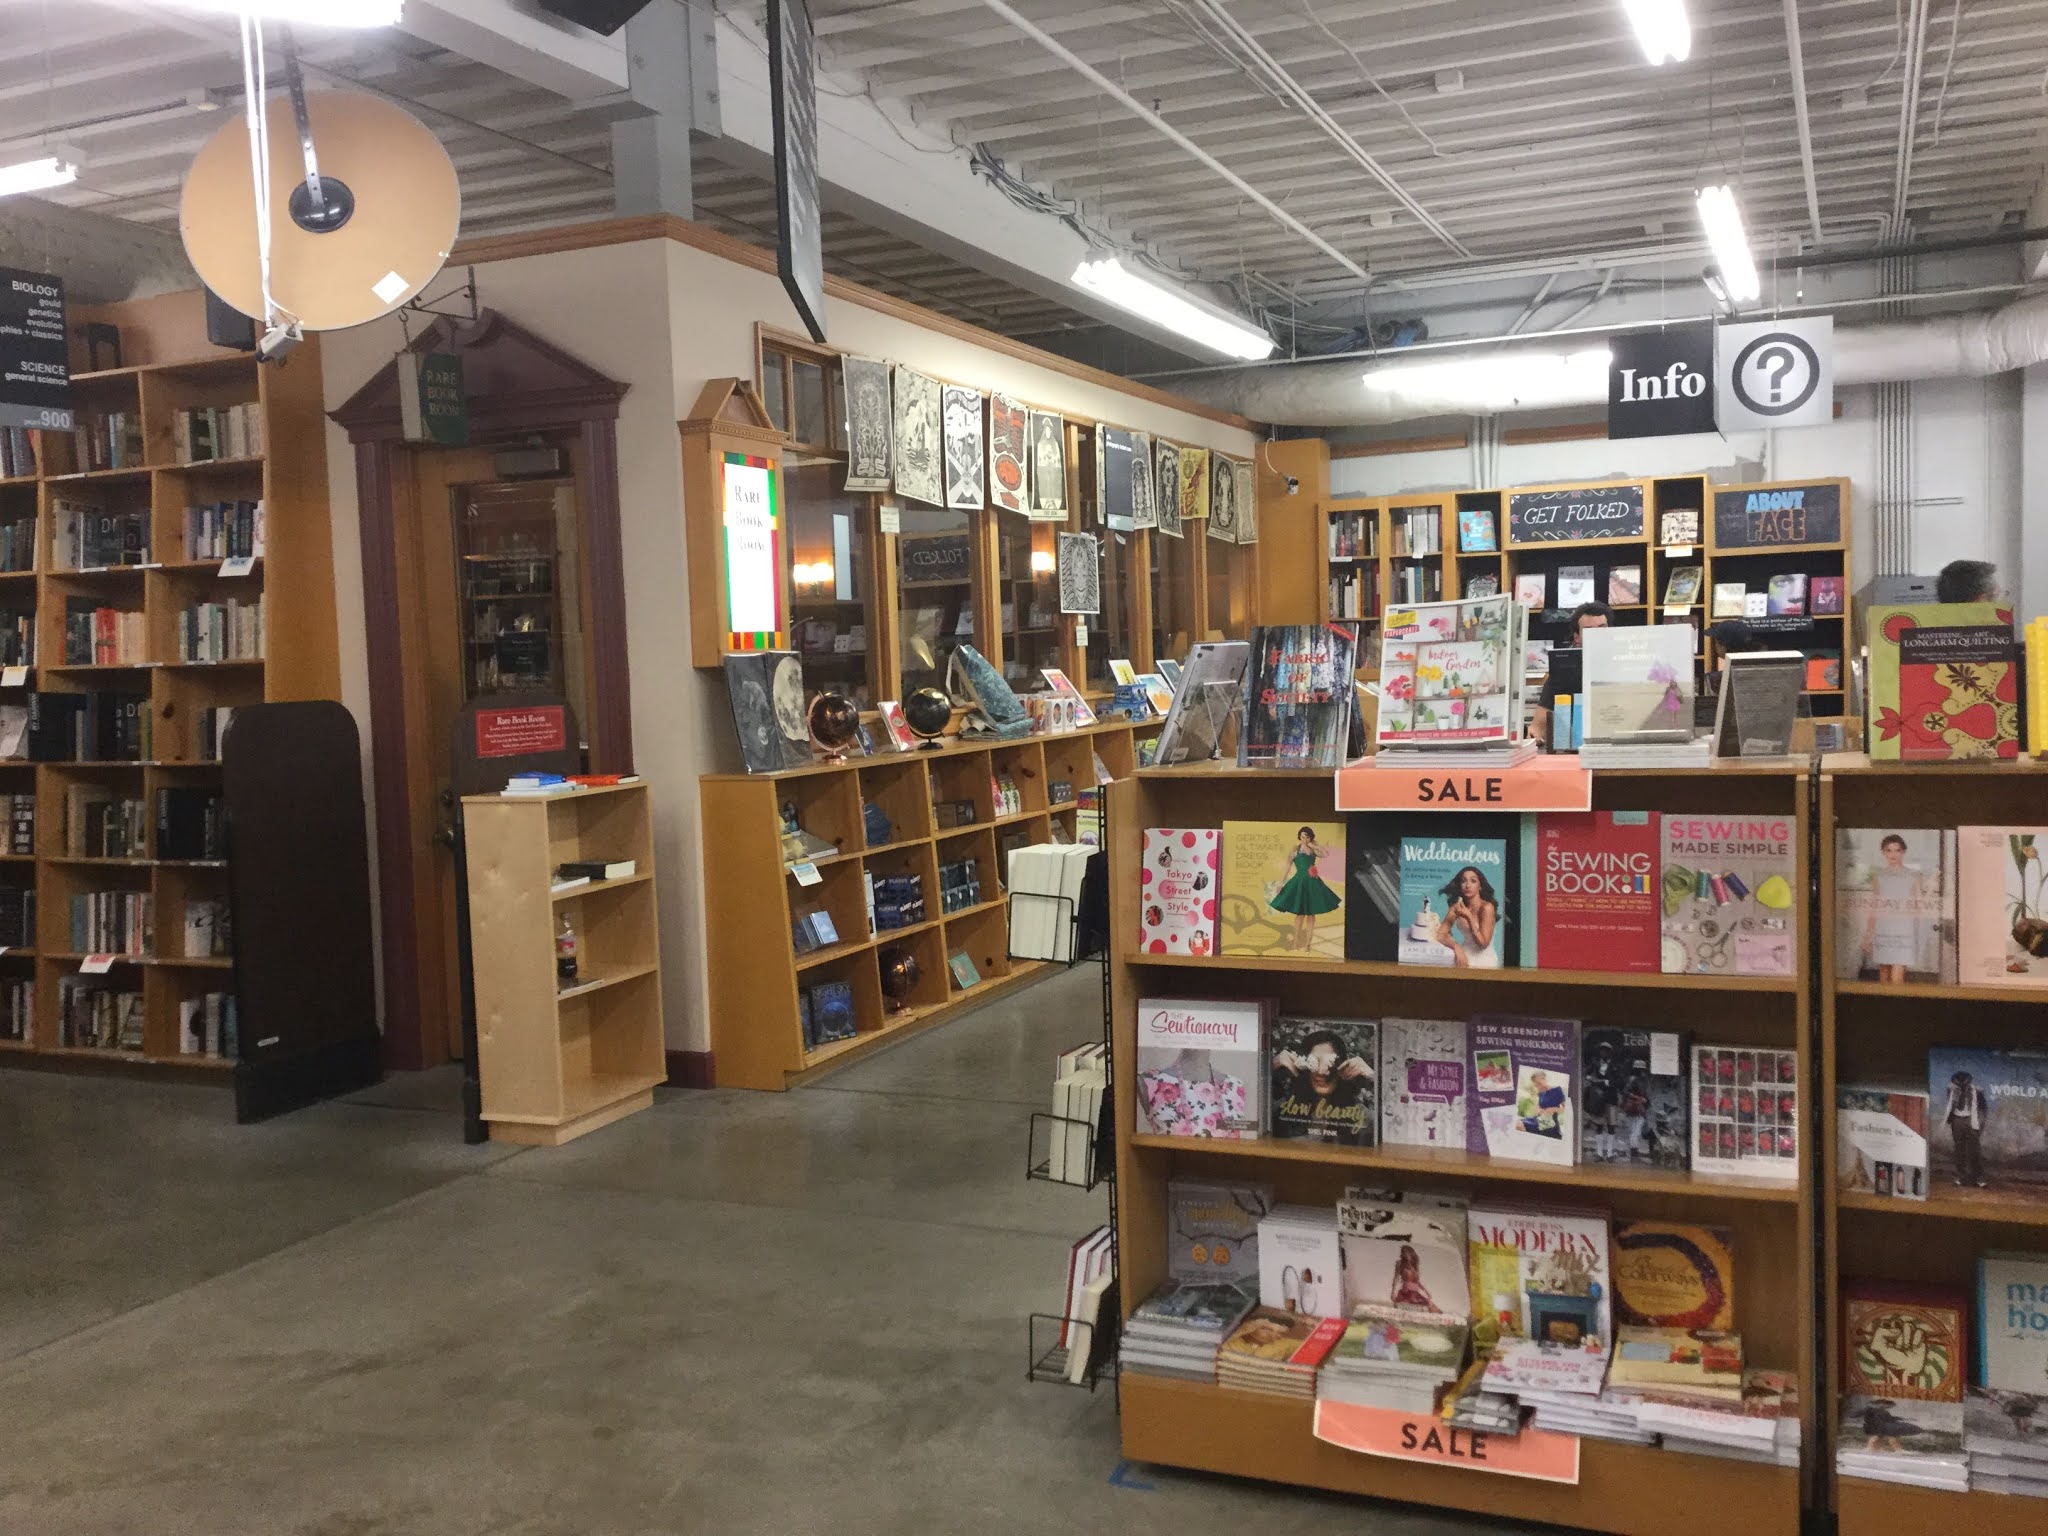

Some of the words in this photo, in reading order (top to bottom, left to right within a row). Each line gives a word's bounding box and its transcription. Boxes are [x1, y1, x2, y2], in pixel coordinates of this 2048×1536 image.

[12, 280, 58, 297] BIOLOGY
[39, 299, 61, 308] gould
[28, 308, 61, 319] genetics
[27, 318, 63, 330] evolution
[31, 330, 63, 341] classics
[21, 361, 66, 375] SCIENCE
[5, 372, 35, 383] general
[37, 376, 68, 386] science
[426, 369, 457, 385] RARE
[1620, 362, 1706, 403] Info
[427, 386, 459, 402] BOOK
[40, 410, 70, 428] 900
[1745, 490, 1805, 513] ABOUT
[1524, 505, 1561, 525] GET
[1565, 502, 1629, 523] FOLKED
[1746, 507, 1806, 542] FACE
[1974, 630, 1989, 638] ART
[1904, 638, 1957, 648] LONGARM
[1958, 637, 2010, 648] QUILTING
[1269, 649, 1330, 666] FABRIC
[1428, 649, 1458, 660] Indoor
[1446, 658, 1480, 671] Garden
[1261, 688, 1329, 704] SOCIETY
[497, 716, 511, 725] Rare
[512, 715, 527, 724] Book
[528, 714, 546, 723] Room
[1418, 777, 1503, 802] SALE
[1669, 821, 1789, 842] SEWING
[1235, 843, 1285, 852] ULTIMATE
[1404, 841, 1500, 865] Weddiculous
[1671, 842, 1720, 854] MADE
[1726, 843, 1788, 855] SIMPLE
[1235, 852, 1269, 860] DRESS
[1547, 852, 1652, 873] SEWING
[1235, 861, 1264, 869] BOOK
[1166, 869, 1192, 880] Tokyo
[1166, 885, 1191, 895] Street
[1546, 873, 1621, 894] BOOK
[1167, 902, 1189, 912] Style
[1151, 1010, 1238, 1043] Sewtionary
[1476, 1025, 1498, 1033] SEW
[1501, 1026, 1564, 1038] SERENDIPITY
[1476, 1036, 1513, 1047] SEWING
[1514, 1038, 1565, 1051] WORKBOOK
[1428, 1077, 1460, 1091] FASHION
[1989, 1084, 2037, 1098] WORLD
[1280, 1094, 1312, 1116] slow
[1315, 1097, 1365, 1135] beauty
[1851, 1121, 1892, 1136] Fashion
[1479, 1225, 1598, 1256] MODERN
[1400, 1422, 1488, 1461] SALE
